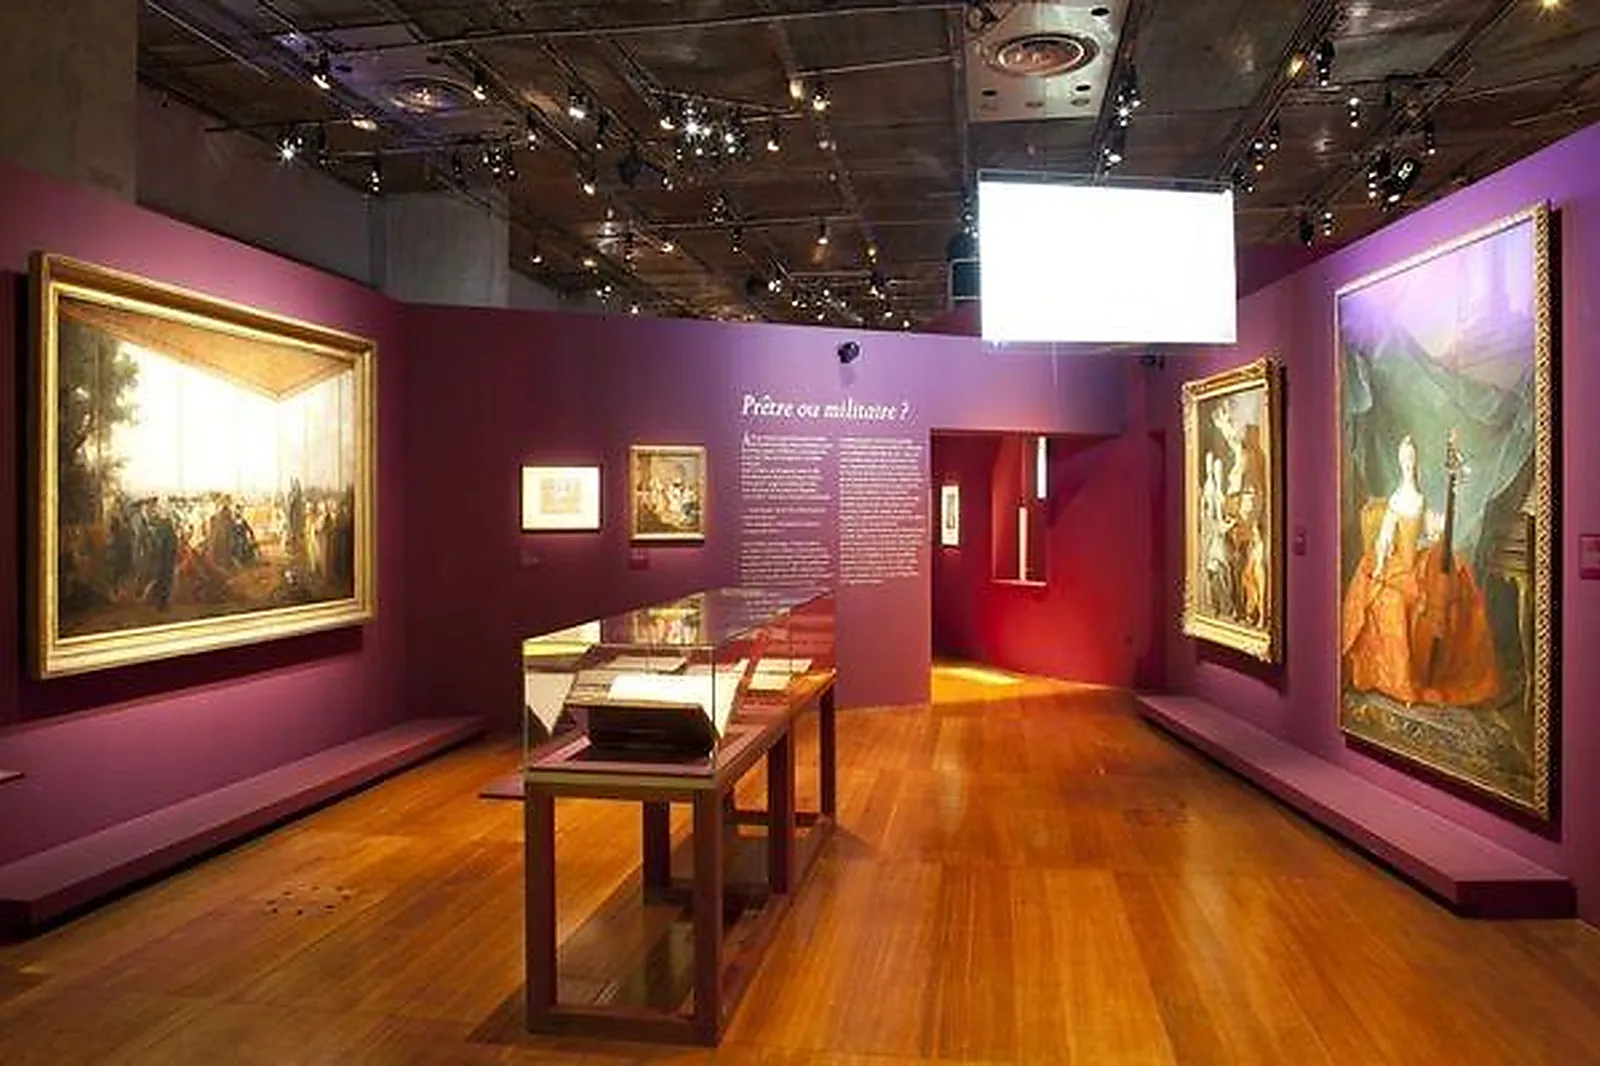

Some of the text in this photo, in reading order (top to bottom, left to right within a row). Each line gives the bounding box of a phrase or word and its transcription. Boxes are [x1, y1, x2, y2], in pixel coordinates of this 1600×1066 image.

[742, 394, 909, 420] Prêtre ou militaire ?
